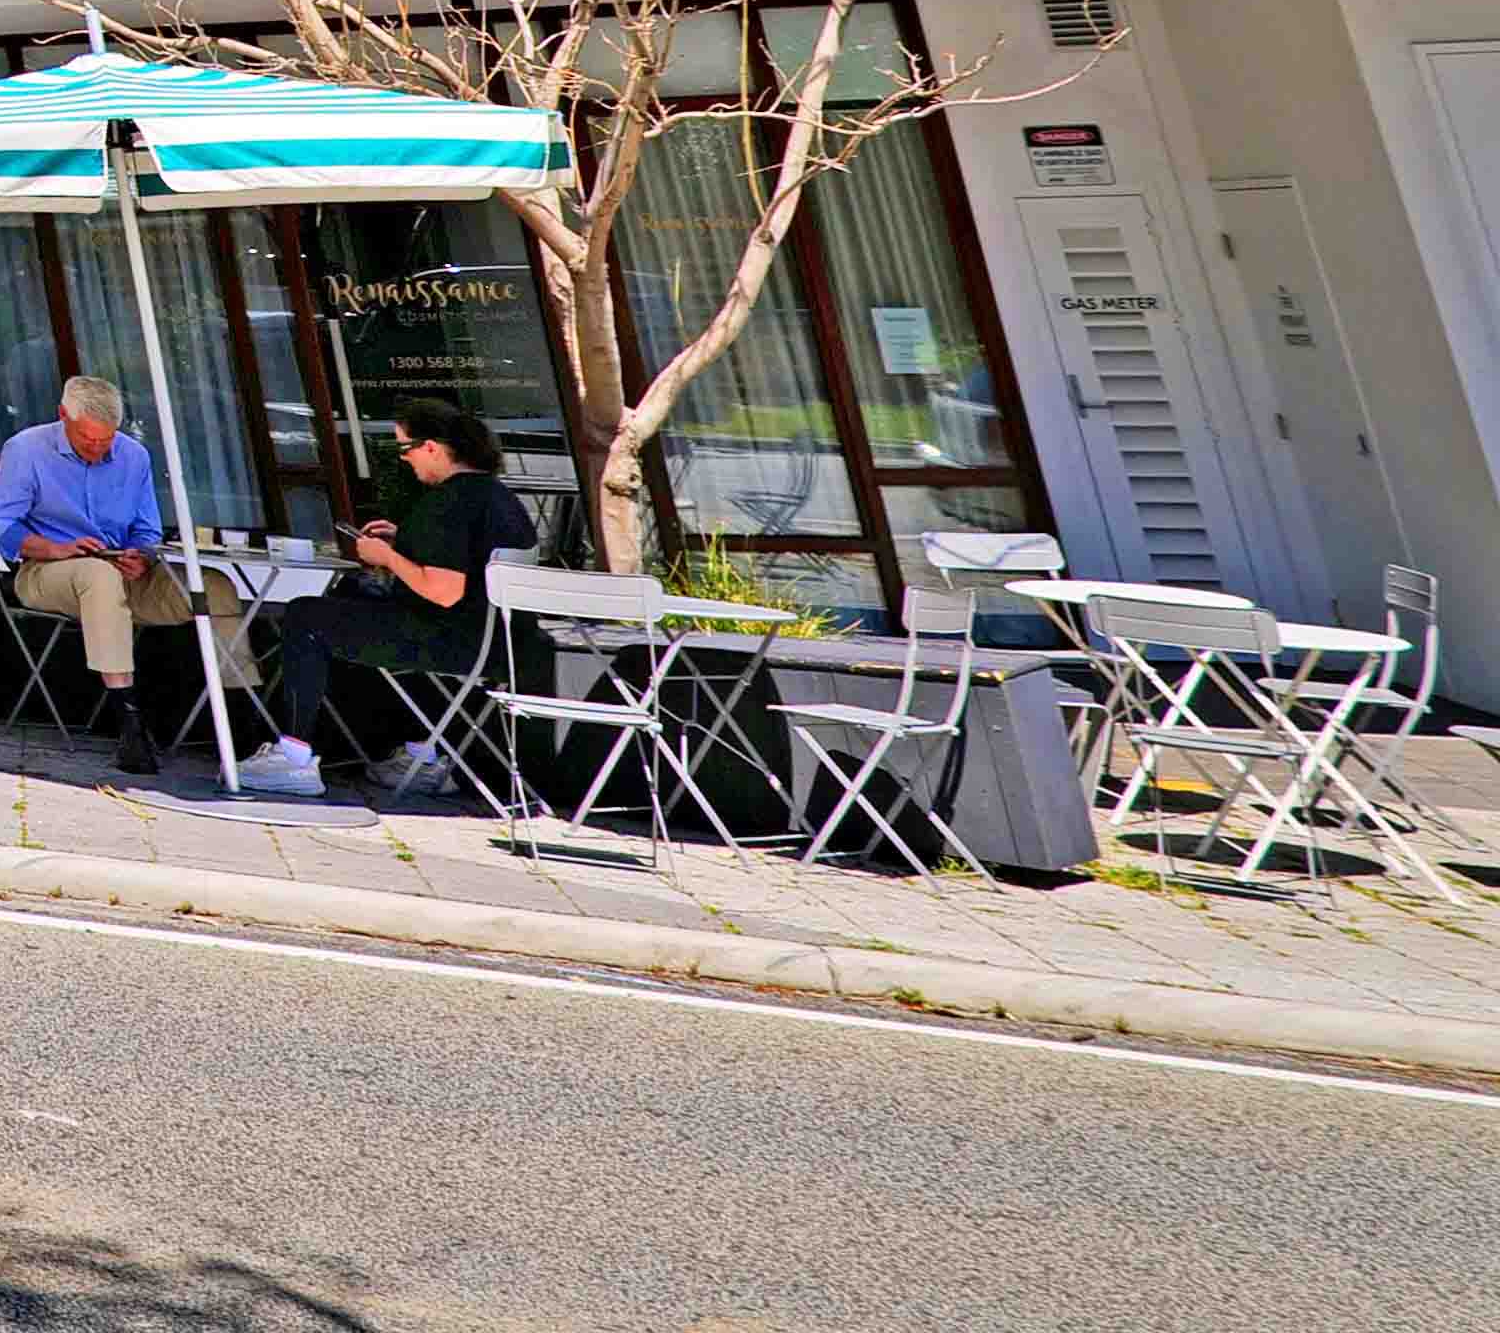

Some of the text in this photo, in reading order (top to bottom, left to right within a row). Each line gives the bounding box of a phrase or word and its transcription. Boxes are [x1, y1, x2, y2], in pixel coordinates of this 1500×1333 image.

[324, 273, 522, 314] Renaissance
[1061, 297, 1159, 310] GAS METER
[388, 356, 424, 369] 1300
